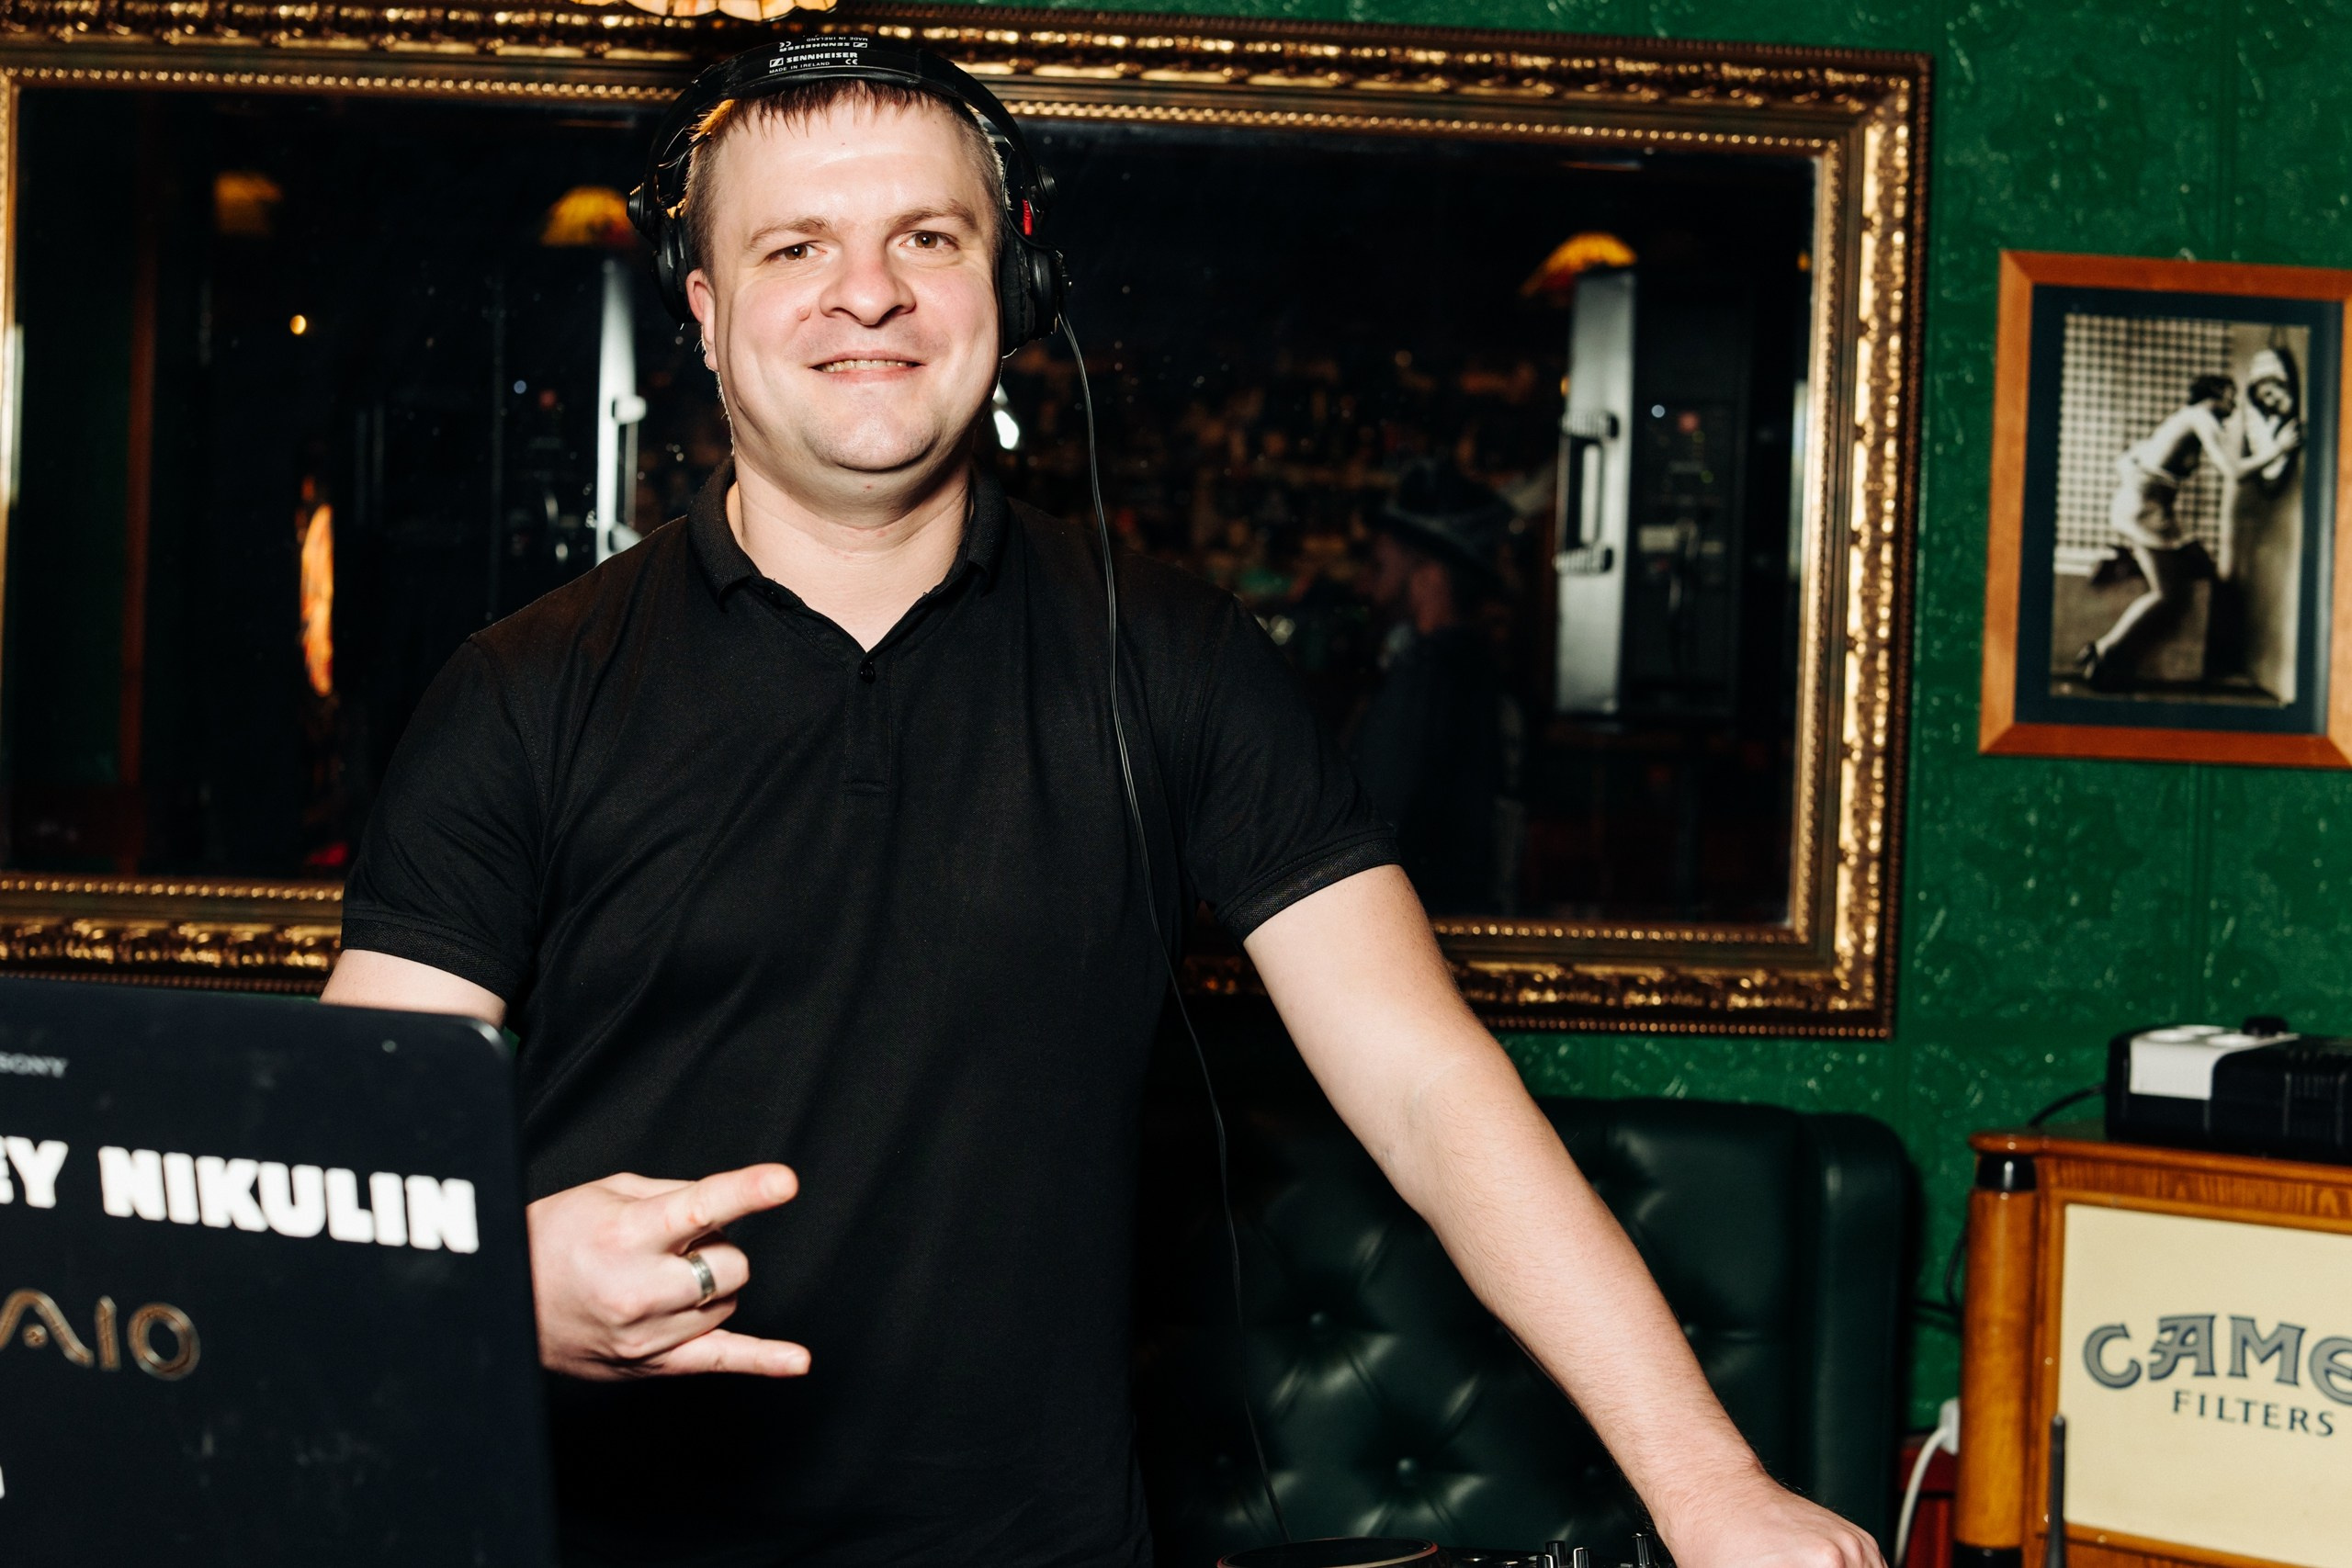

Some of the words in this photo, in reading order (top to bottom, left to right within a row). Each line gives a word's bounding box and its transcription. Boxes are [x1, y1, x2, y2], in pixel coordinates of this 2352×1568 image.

[786, 52, 858, 63] SENNHEISER
[0, 1051, 69, 1078] SONY
[98, 1145, 480, 1254] NIKULIN
[2172, 1389, 2335, 1438] FILTERS
